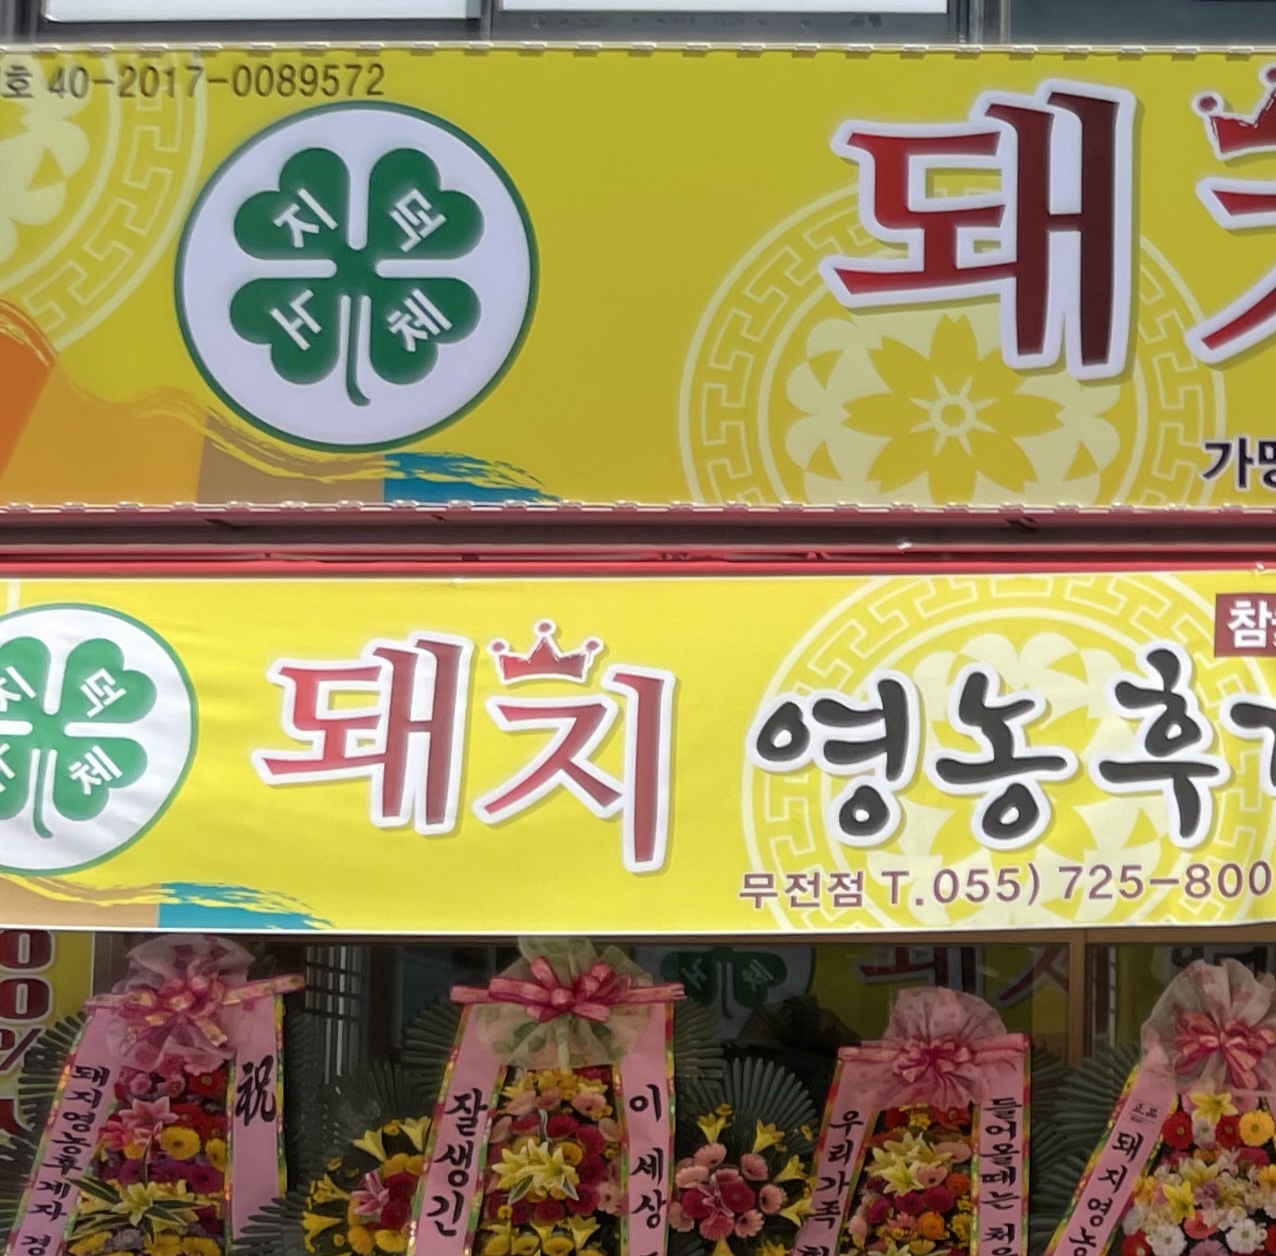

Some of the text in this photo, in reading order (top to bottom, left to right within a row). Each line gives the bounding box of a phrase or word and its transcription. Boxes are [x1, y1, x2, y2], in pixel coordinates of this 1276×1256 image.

[49, 63, 386, 99] 40-2017-0089572
[273, 188, 446, 253] 지 덕
[269, 287, 453, 353] 노 체
[68, 744, 124, 796] 체
[260, 638, 668, 865] 돼지
[737, 870, 866, 912] 무전점
[235, 1054, 278, 1127] 祝
[628, 1083, 662, 1122] 이
[28, 1064, 111, 1222] 돼지영농후계자
[426, 1086, 490, 1237] 잘생긴
[814, 1109, 864, 1230] 우리가족
[629, 1146, 666, 1230] 세상
